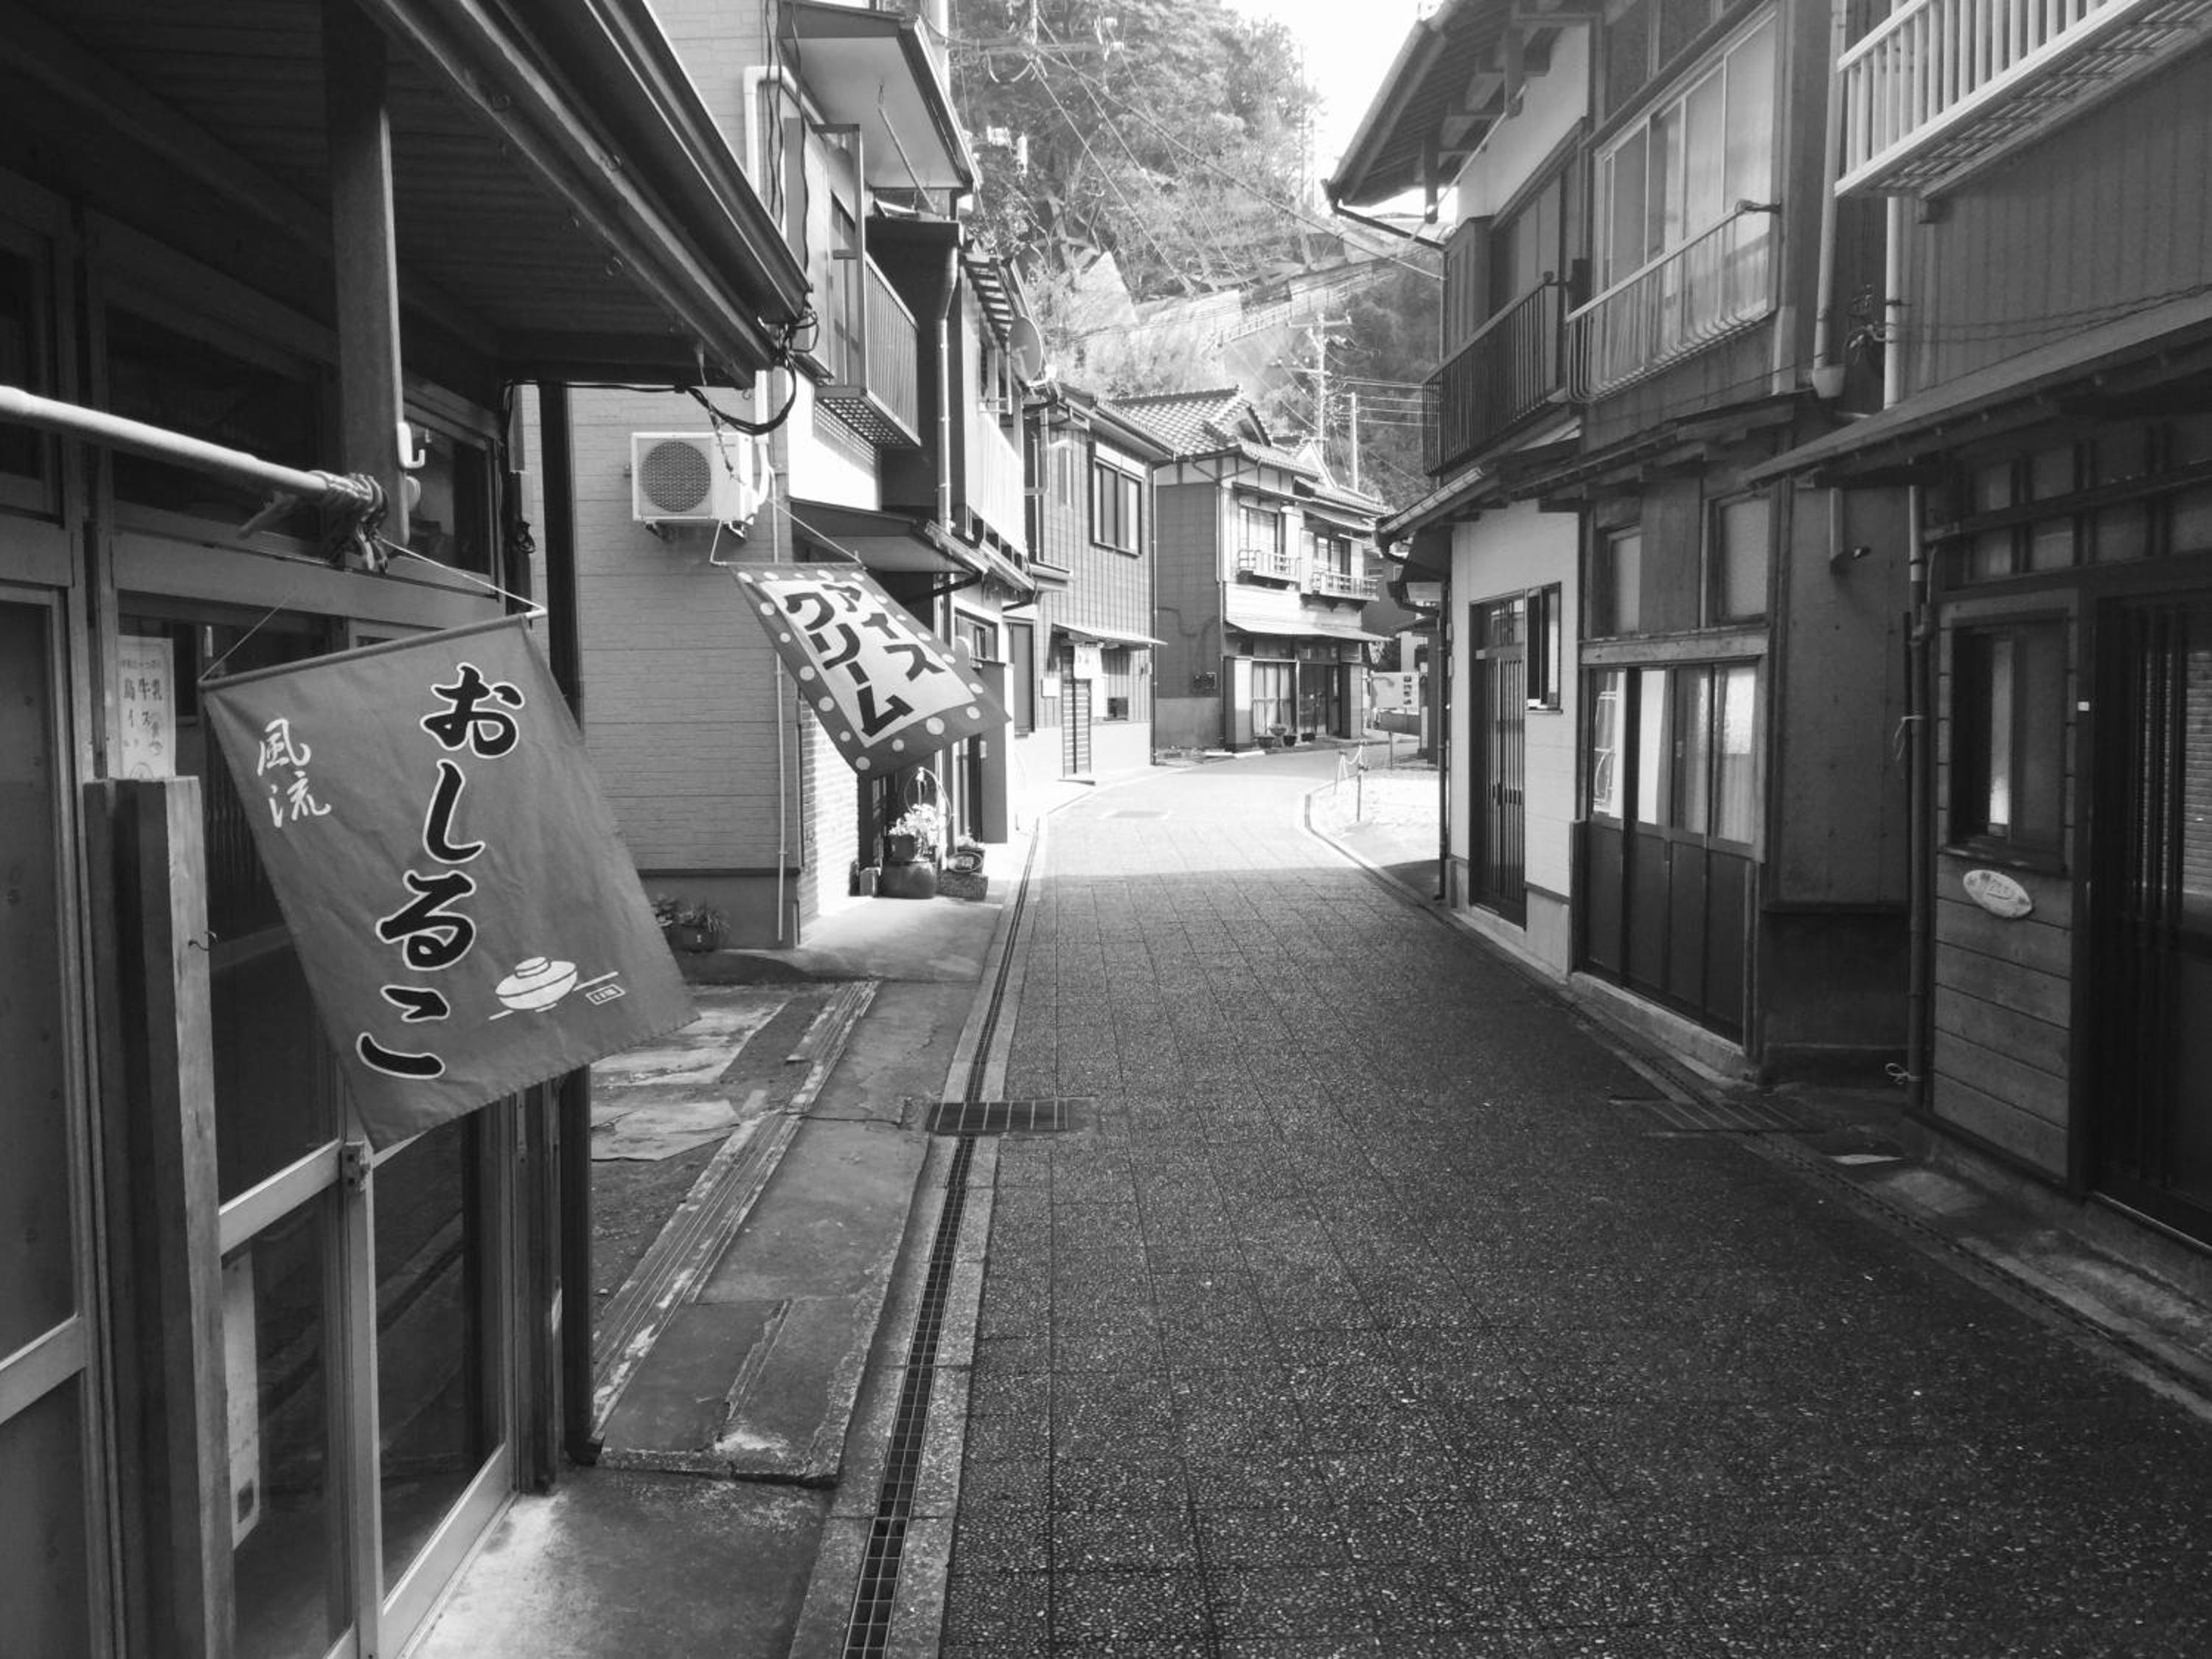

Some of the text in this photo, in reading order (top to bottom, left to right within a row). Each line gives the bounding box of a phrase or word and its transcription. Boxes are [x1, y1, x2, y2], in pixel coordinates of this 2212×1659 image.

[785, 591, 915, 737] クリーム
[820, 582, 946, 681] アイス
[257, 717, 332, 828] 風流
[355, 662, 525, 1078] おしるこ
